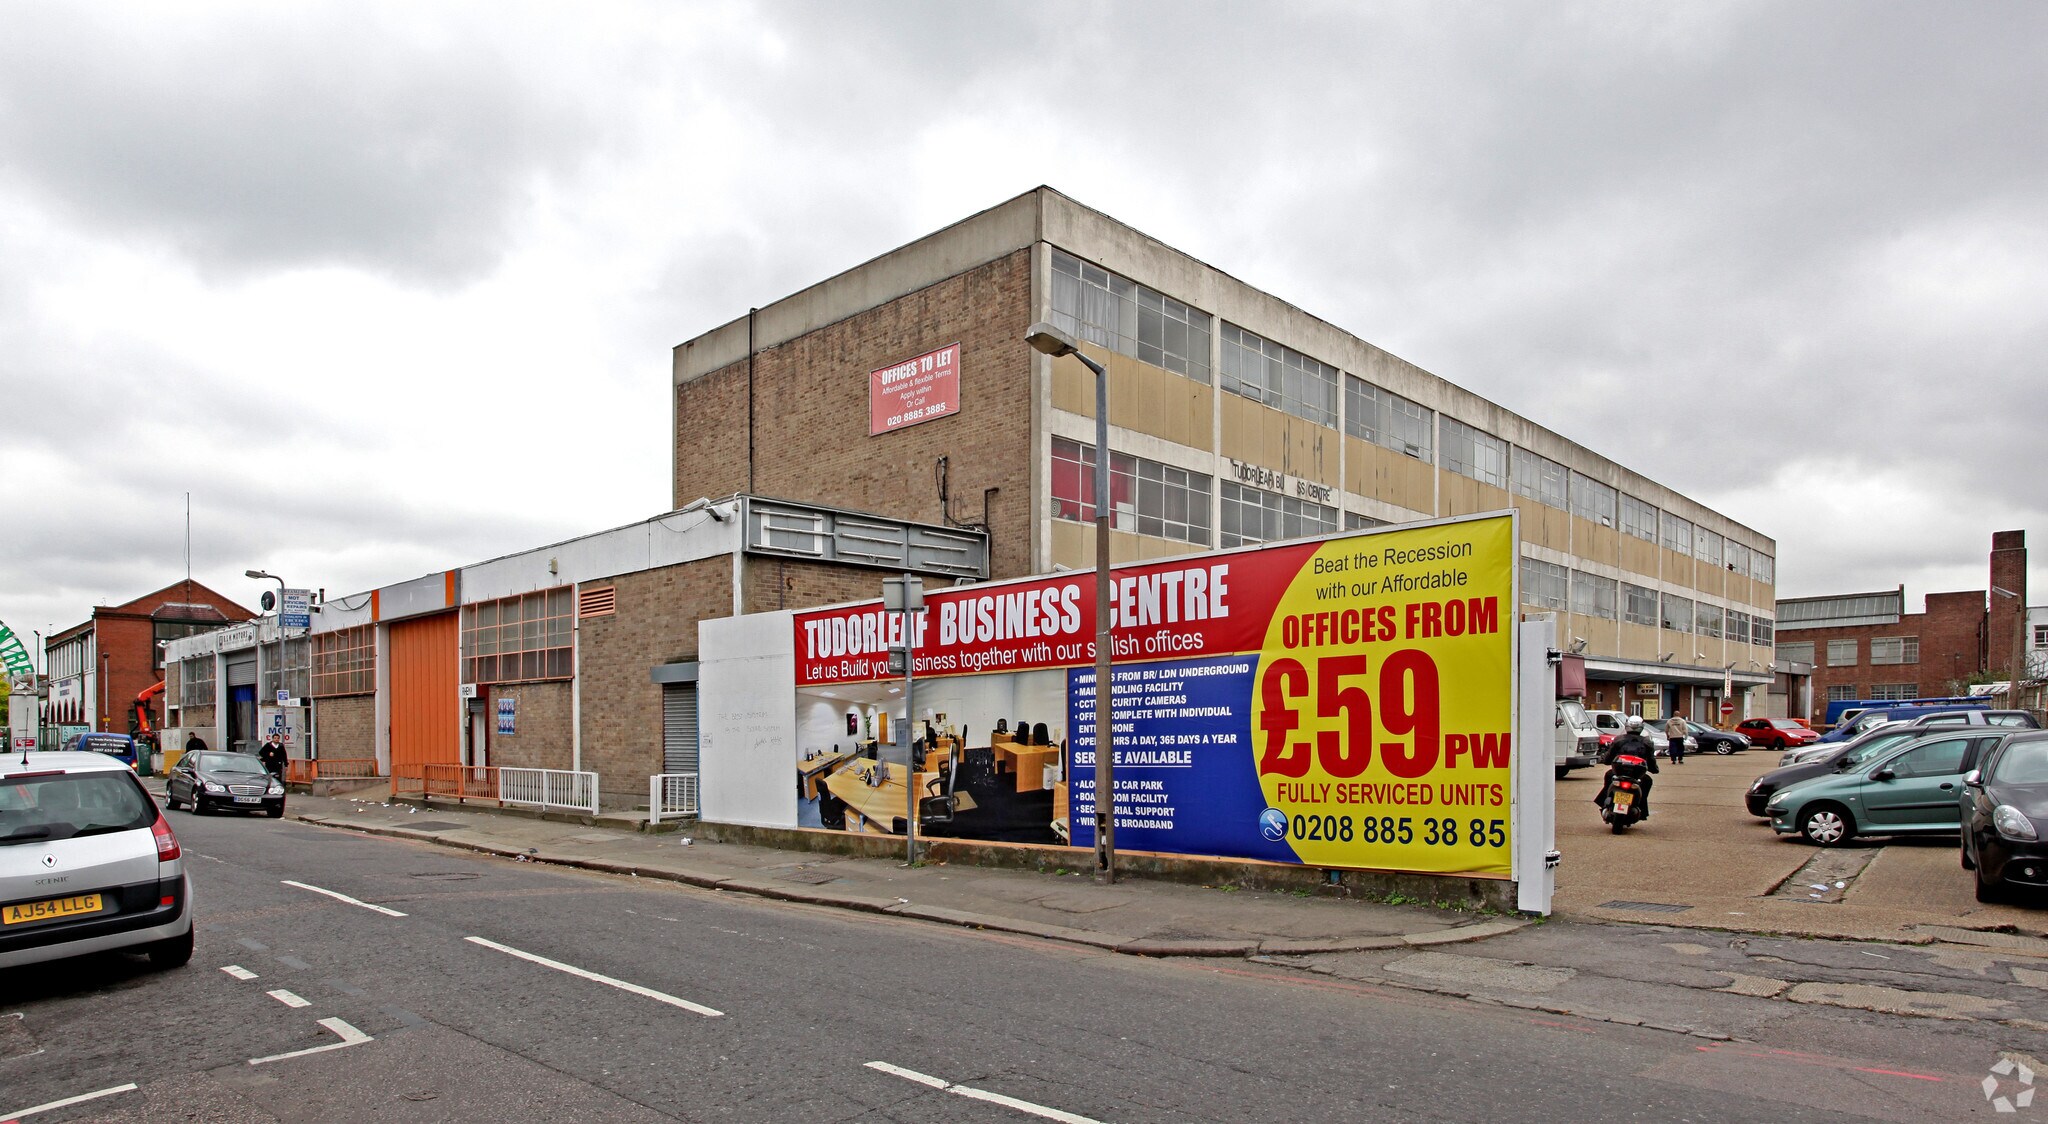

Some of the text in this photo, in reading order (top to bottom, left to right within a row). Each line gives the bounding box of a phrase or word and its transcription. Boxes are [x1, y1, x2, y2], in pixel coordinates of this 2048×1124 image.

[882, 349, 952, 385] OFFICES TO LET
[882, 382, 908, 395] Affordable
[914, 374, 933, 385] flexible
[934, 369, 951, 379] Terms
[900, 385, 931, 400] Apply within
[906, 397, 925, 408] Or Call
[887, 402, 946, 426] 020 8885 3885
[1308, 484, 1330, 502] CENTRE
[1314, 541, 1471, 574] Beat the Recession
[1316, 568, 1467, 600] with our Affordable
[805, 606, 929, 659] TUDORLEAF
[940, 585, 1080, 646] BUSINESS
[1282, 596, 1498, 649] OFFICES FROM
[806, 631, 1204, 680] Let us Build you siness together with our slish offices
[1117, 671, 1140, 682] FROM
[1143, 670, 1157, 680] BR/
[1159, 669, 1176, 679] LDN
[1179, 664, 1249, 677] UNDERGROUND
[1079, 682, 1184, 696] MAIL NDLING FACILITY
[1112, 697, 1142, 707] CURITY
[1145, 695, 1187, 706] CAMERAS
[1112, 709, 1152, 720] OMPLETE
[1154, 708, 1177, 718] WITH
[1179, 706, 1232, 717] INDIVIDUAL
[1260, 649, 1511, 778] £59 PW
[1079, 734, 1237, 746] OPE HRS A DAY, 365 DAYS A YEAR
[1075, 751, 1192, 764] SERE AVAILABLE
[1122, 781, 1138, 789] CAR
[1141, 781, 1163, 790] PARK
[1277, 782, 1503, 806] FULLY SERVICED UNITS
[1131, 794, 1168, 803] FACILITY
[1617, 803, 1624, 811] L
[1080, 805, 1174, 816] SECRIAL SUPPORT
[1122, 819, 1173, 829] BROADBAND
[1293, 814, 1506, 847] 0208 885 38 85
[35, 876, 69, 885] SCENIC
[12, 896, 95, 920] AJ54 LLG
